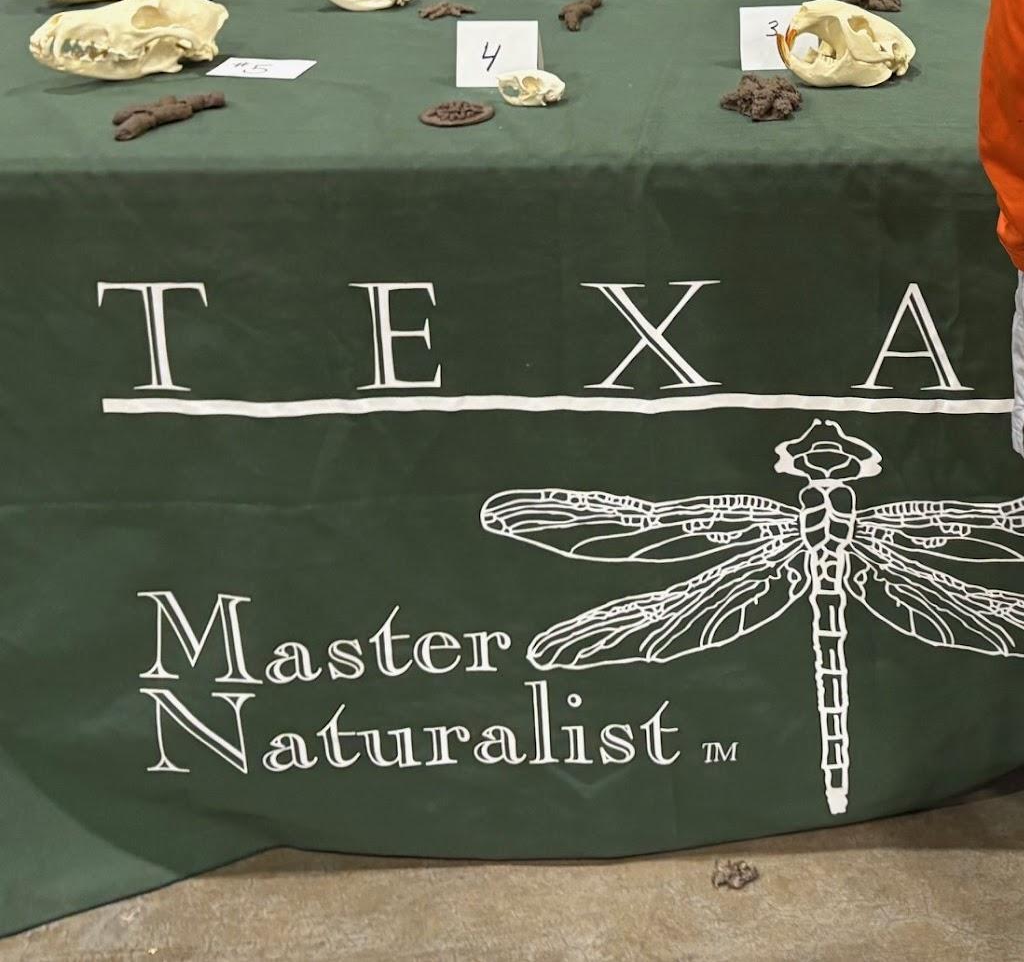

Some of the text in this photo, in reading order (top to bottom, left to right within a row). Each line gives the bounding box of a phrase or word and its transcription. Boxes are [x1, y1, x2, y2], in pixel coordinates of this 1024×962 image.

[482, 41, 501, 72] 4
[766, 20, 780, 37] 3
[97, 280, 974, 392] TEXA
[137, 590, 512, 685] Master
[139, 680, 739, 775] Naturalist TM
